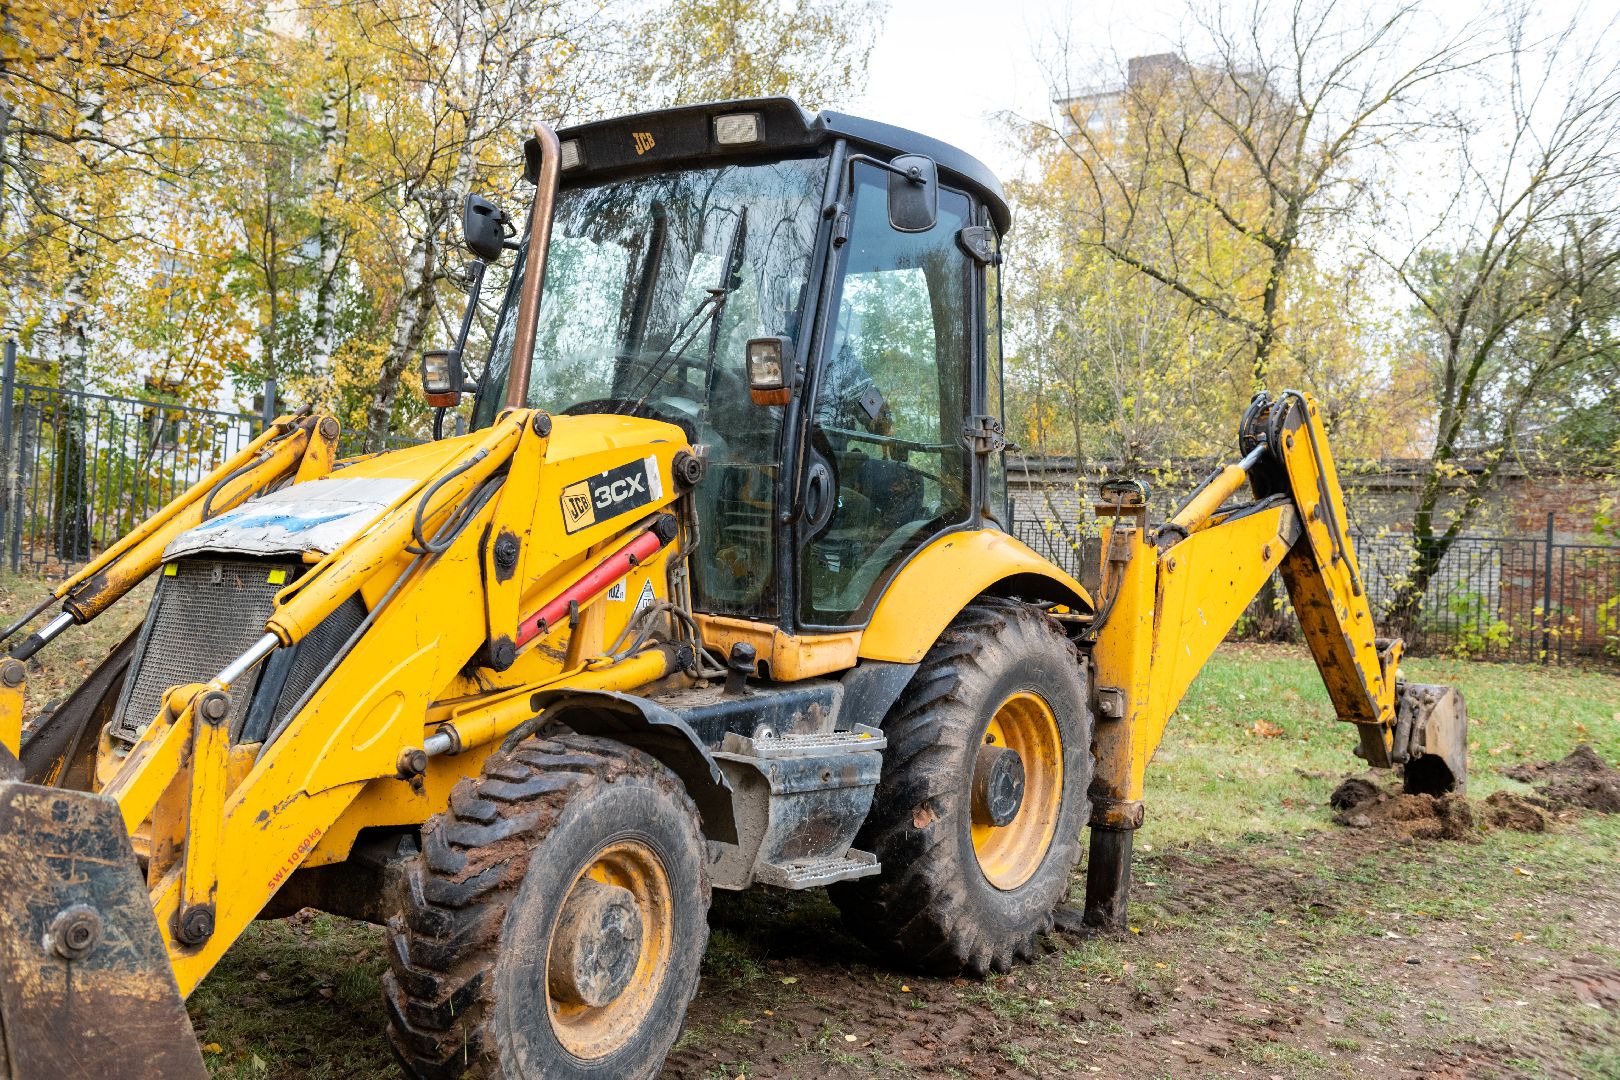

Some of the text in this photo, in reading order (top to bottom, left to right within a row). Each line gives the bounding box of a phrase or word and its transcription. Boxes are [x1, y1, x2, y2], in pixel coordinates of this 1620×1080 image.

[632, 132, 656, 155] JCB
[568, 472, 645, 519] JCB 3CX
[267, 866, 289, 890] SWL
